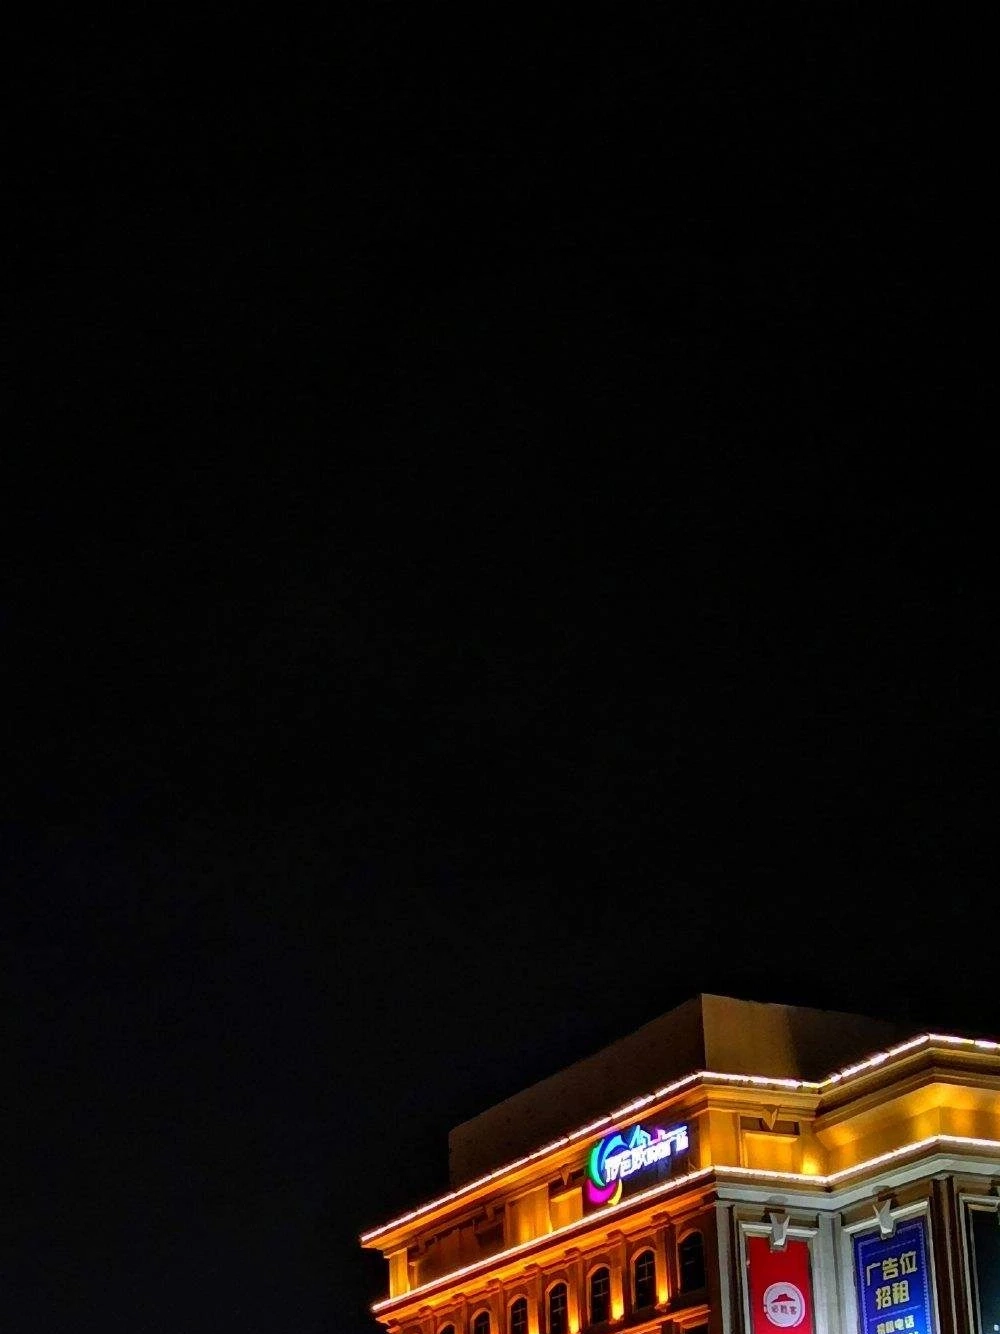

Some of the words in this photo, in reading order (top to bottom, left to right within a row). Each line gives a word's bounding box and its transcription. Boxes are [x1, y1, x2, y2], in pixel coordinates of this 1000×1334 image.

[866, 1251, 918, 1286] 广告位
[876, 1280, 910, 1310] 招租
